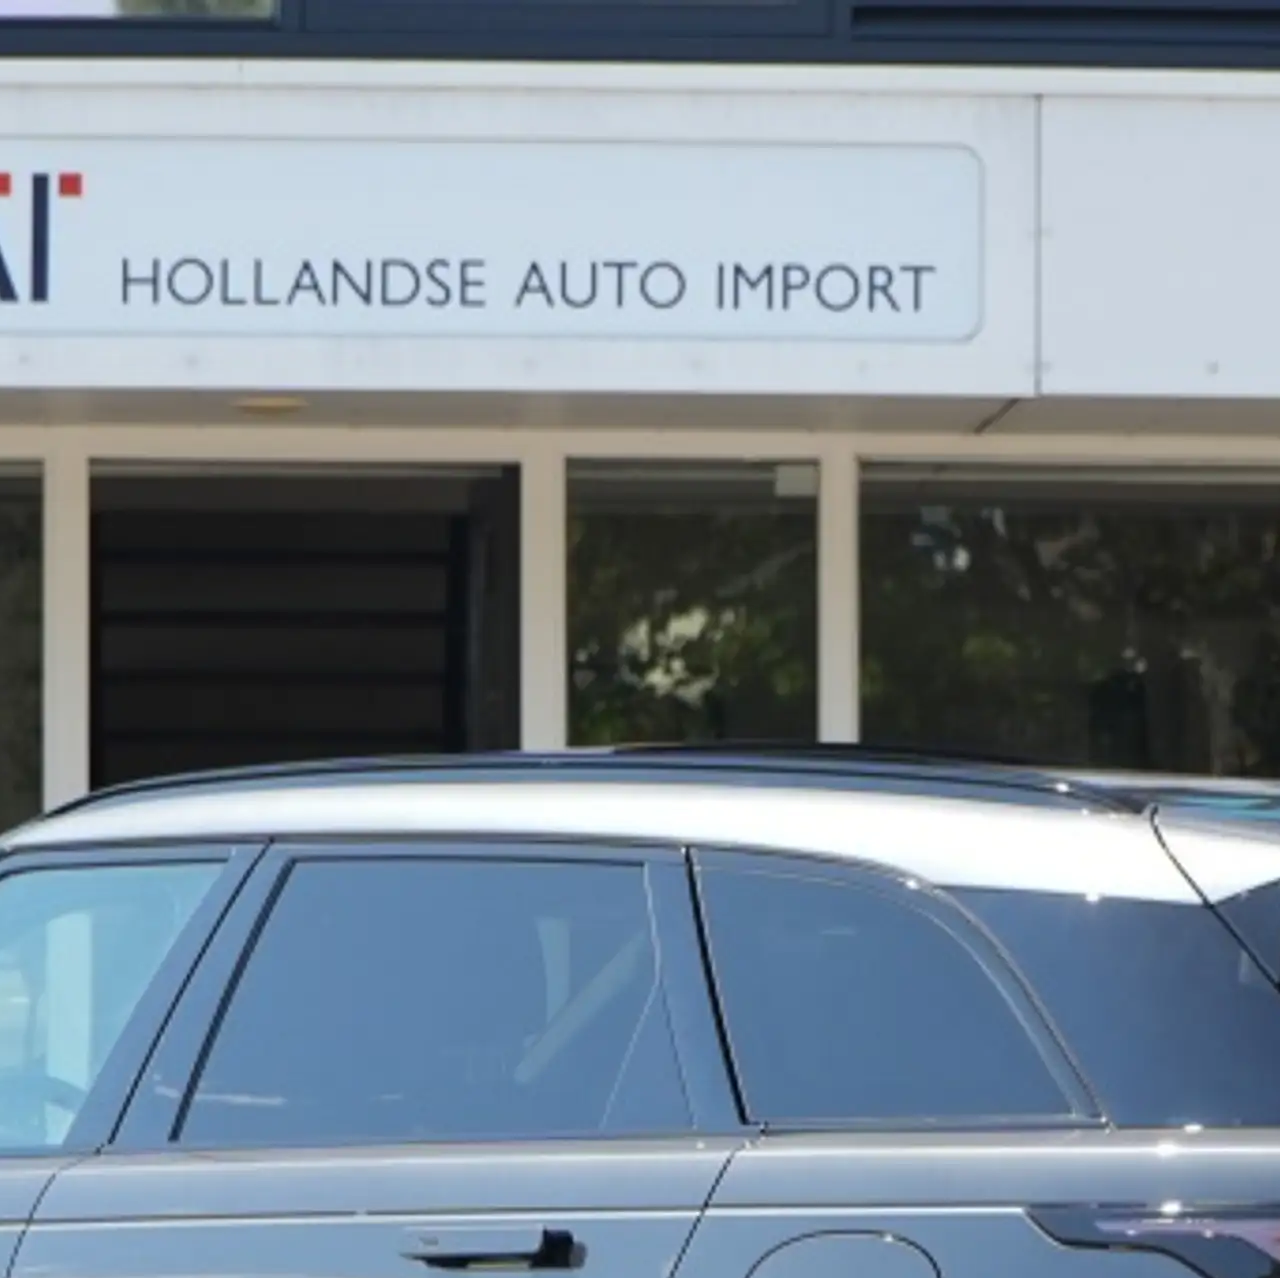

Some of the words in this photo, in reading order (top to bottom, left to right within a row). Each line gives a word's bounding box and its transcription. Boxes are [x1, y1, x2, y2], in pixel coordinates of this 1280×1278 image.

[121, 257, 486, 308] HOLLANDSE
[514, 260, 687, 310] AUTO
[716, 262, 937, 313] IMPORT
